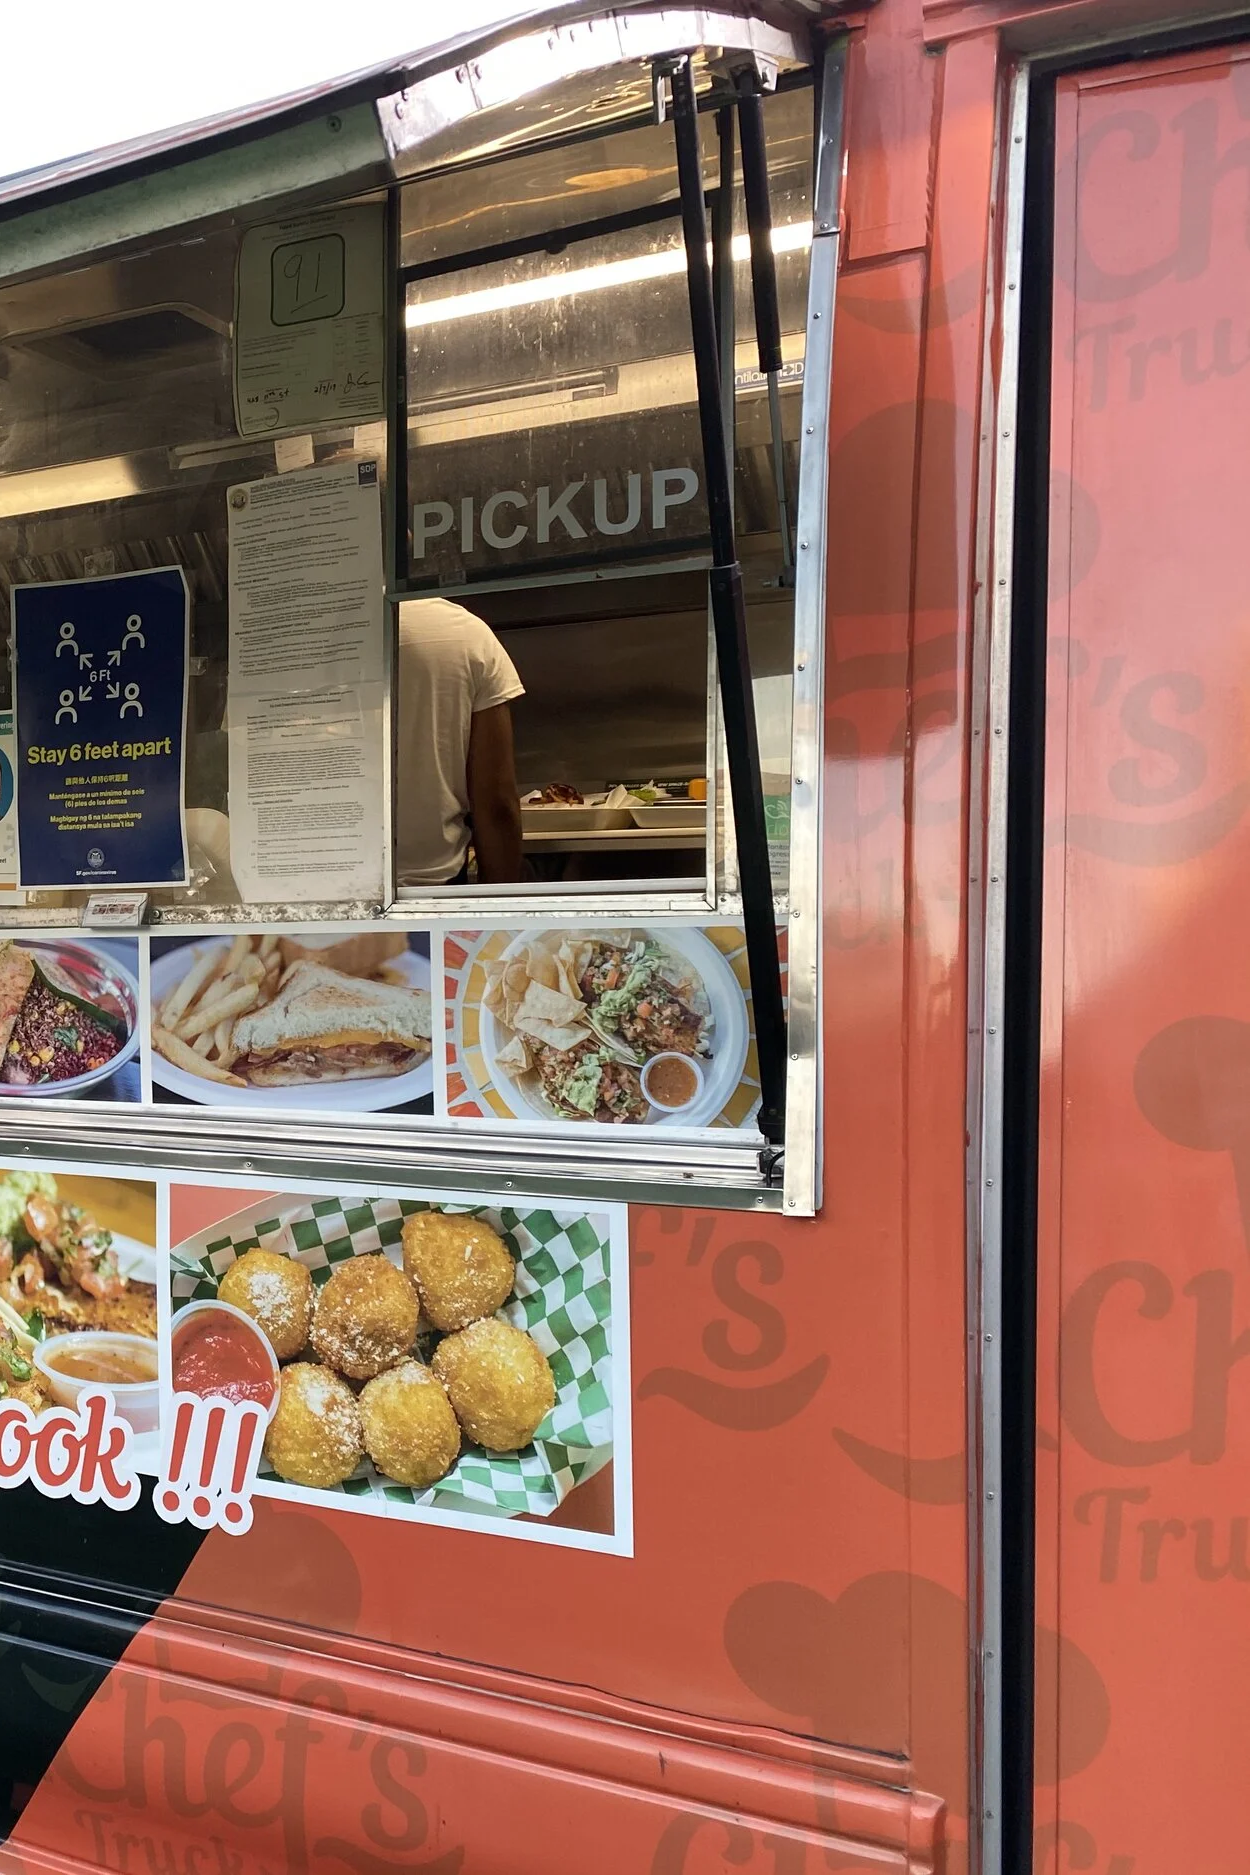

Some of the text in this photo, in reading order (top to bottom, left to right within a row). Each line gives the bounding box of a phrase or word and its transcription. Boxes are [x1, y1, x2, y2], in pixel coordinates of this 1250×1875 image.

[283, 252, 321, 302] 91
[360, 464, 377, 474] SDP
[413, 467, 699, 559] PICKUP
[89, 669, 111, 683] 6 Ft
[27, 736, 172, 767] Stay 6 feet apart
[64, 800, 74, 808] (6)
[74, 800, 88, 808] pies
[96, 798, 106, 806] los
[49, 815, 79, 824] Magbigay
[101, 812, 142, 820] talampakang
[58, 822, 87, 831] distansya
[157, 1399, 263, 1529] !!!
